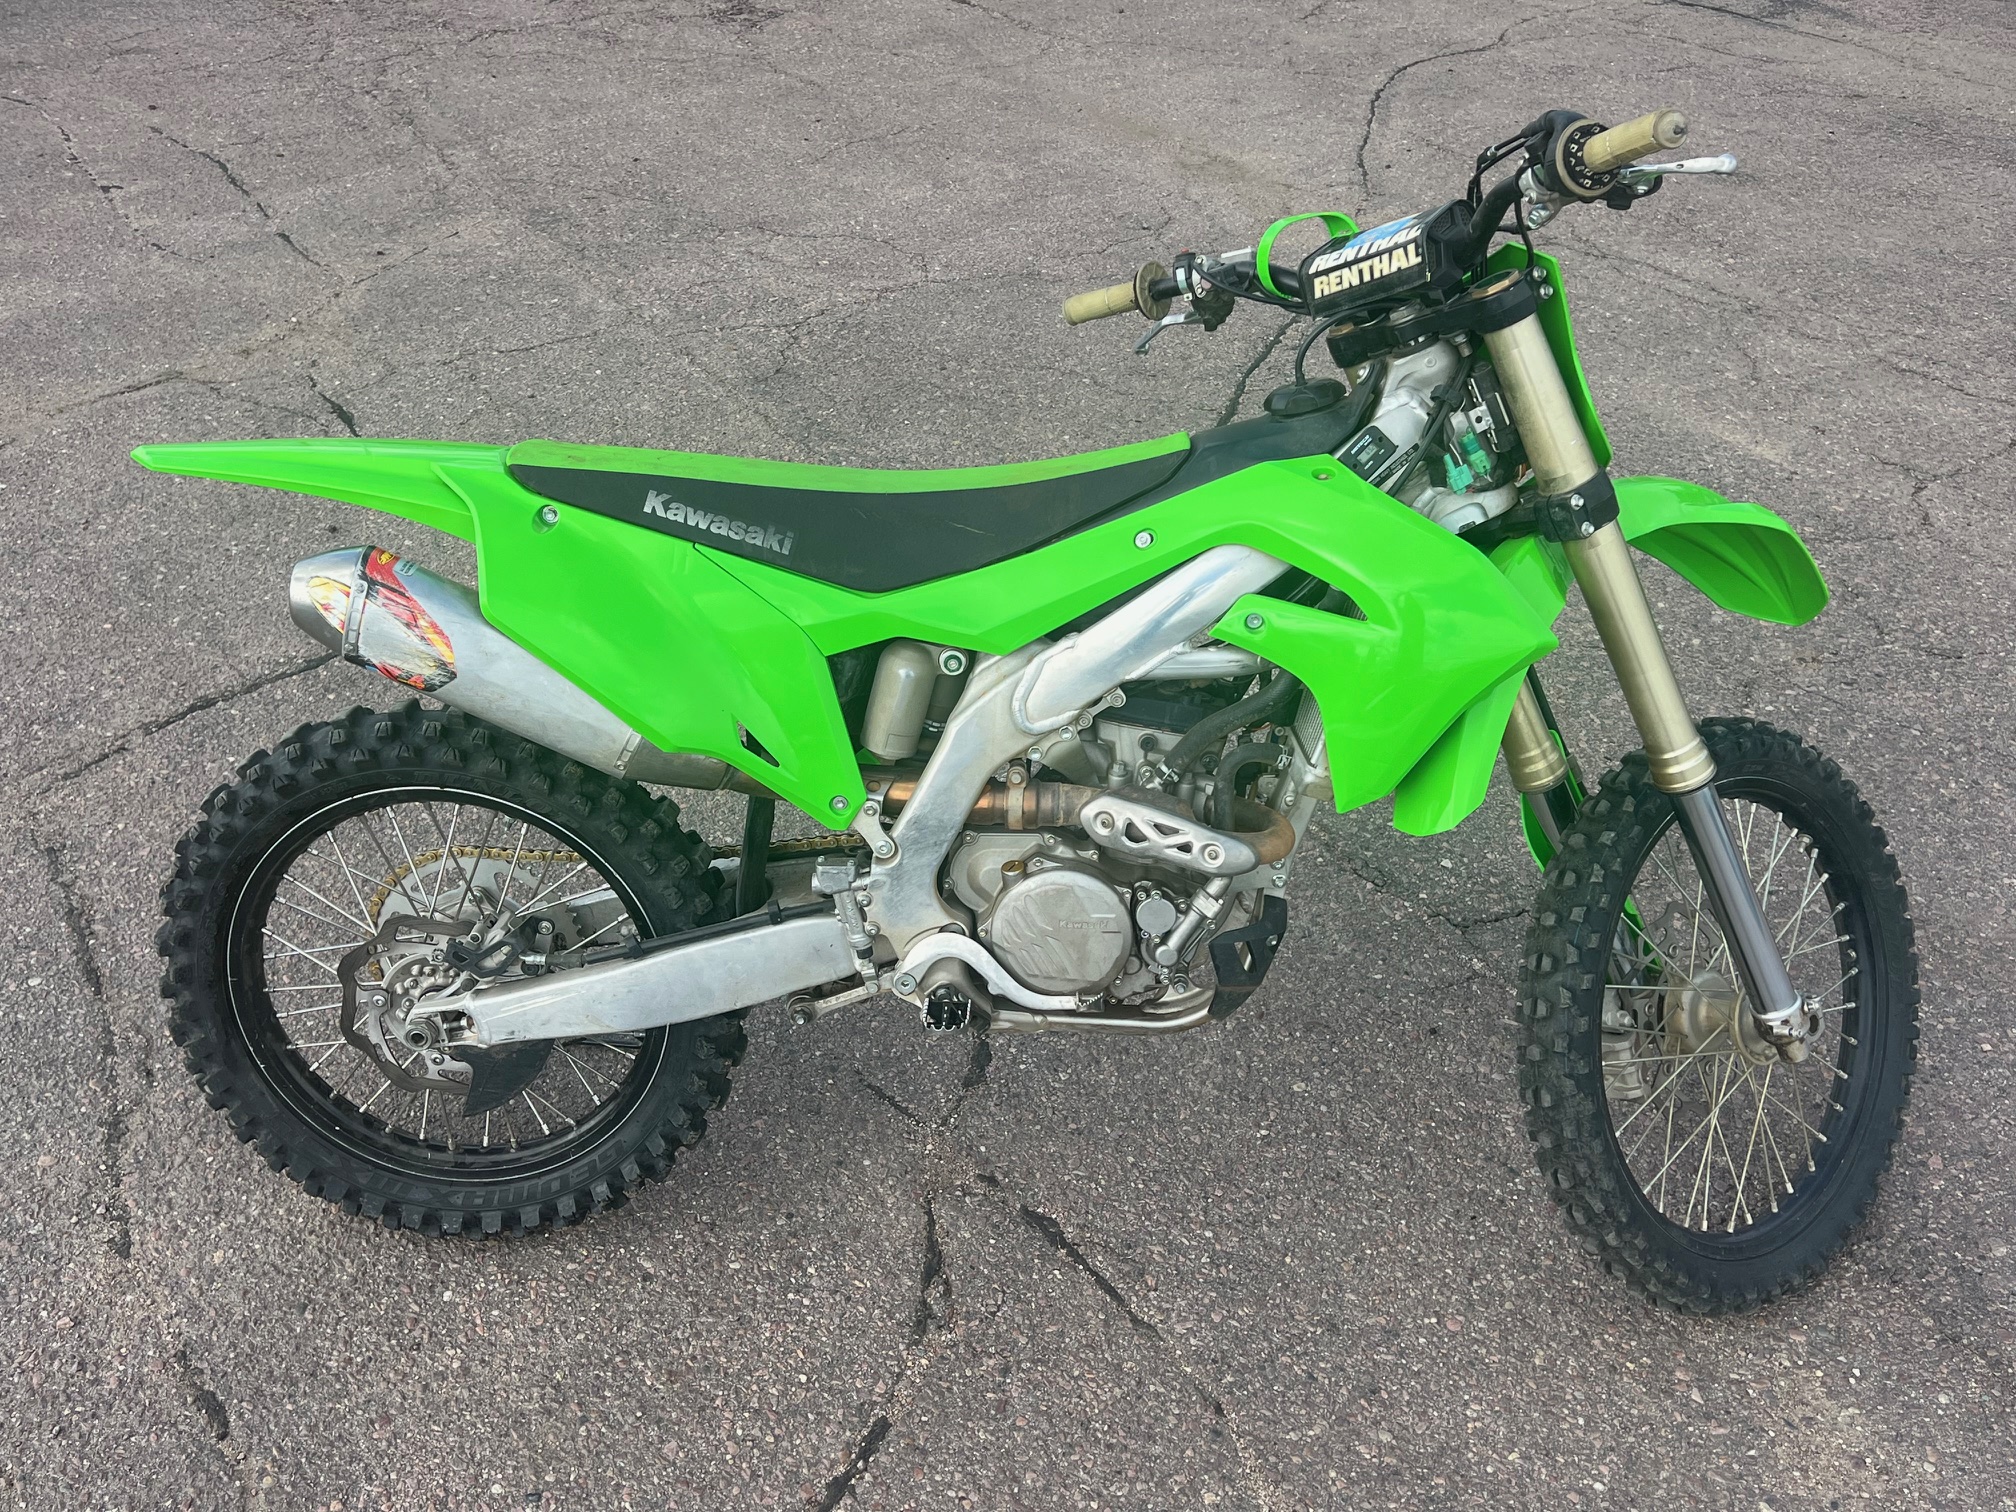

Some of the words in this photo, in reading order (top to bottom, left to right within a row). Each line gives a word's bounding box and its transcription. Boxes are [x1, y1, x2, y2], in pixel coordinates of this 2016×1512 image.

[1309, 224, 1421, 274] RENTHAL
[1313, 243, 1422, 300] RENTHAL
[643, 489, 794, 555] Kawasaki
[423, 1139, 630, 1206] GEOMAX
